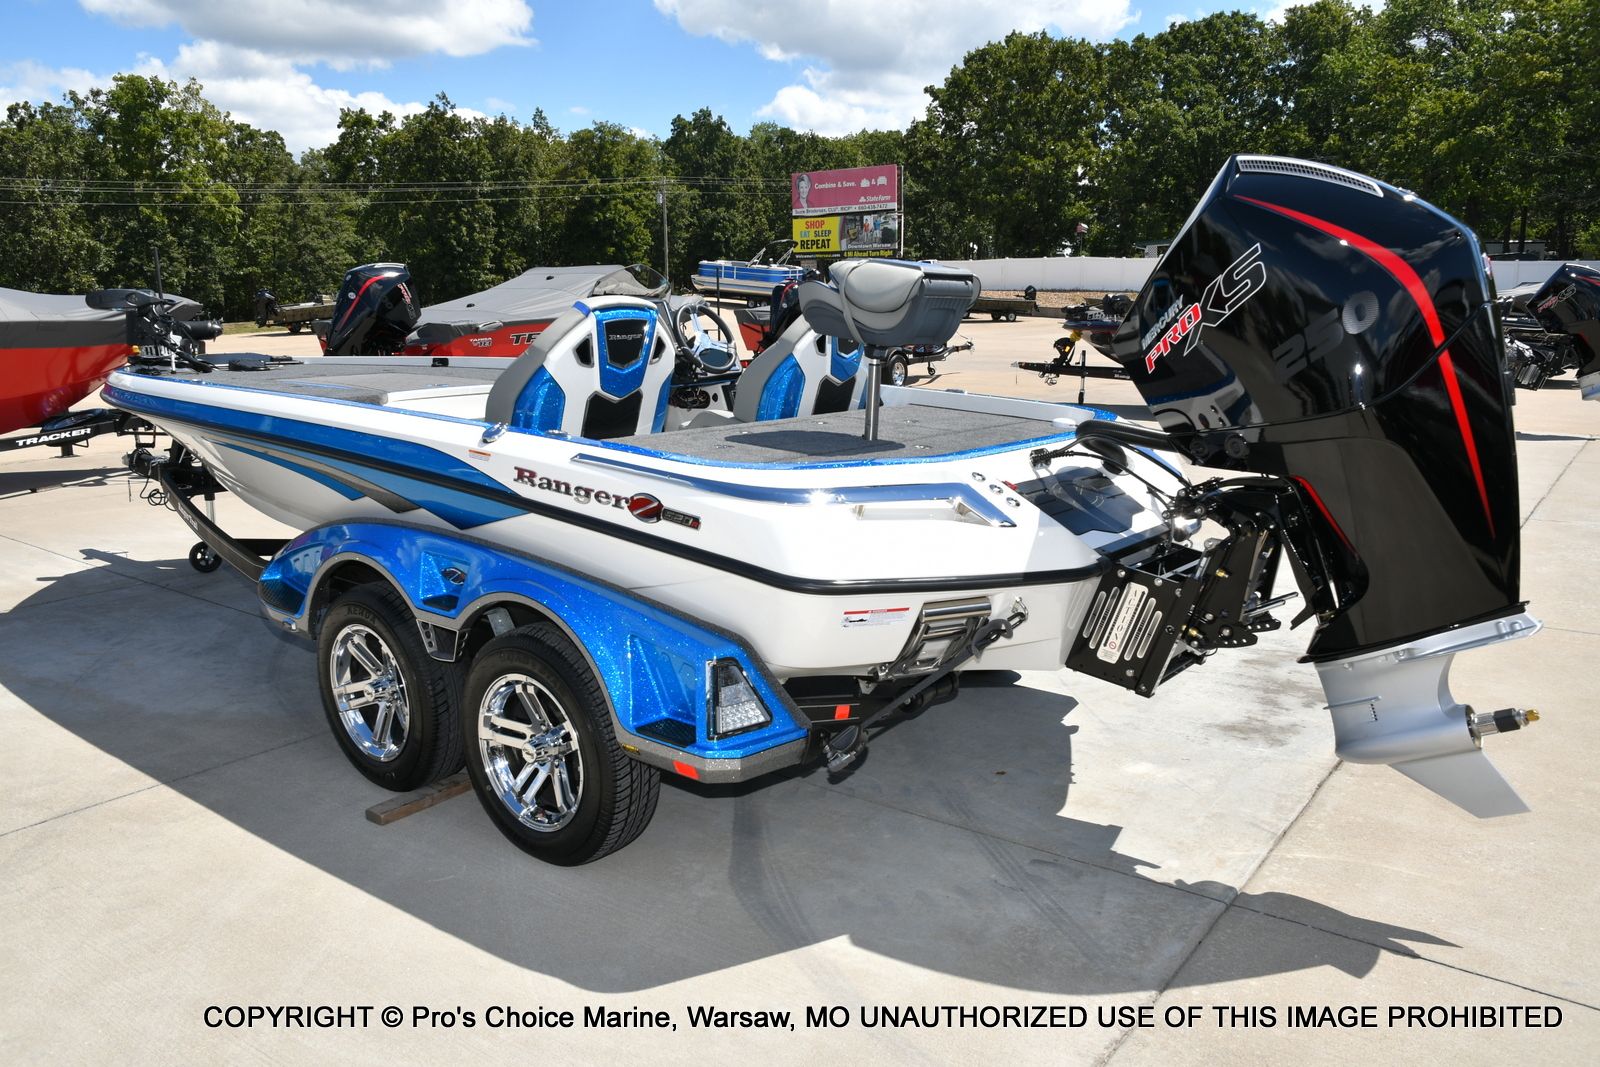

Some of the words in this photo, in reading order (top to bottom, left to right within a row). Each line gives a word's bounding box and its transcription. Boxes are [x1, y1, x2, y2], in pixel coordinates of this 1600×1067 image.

[805, 220, 825, 229] SHOP
[814, 230, 832, 238] SLEEP
[800, 238, 831, 250] REPEAT
[880, 249, 893, 258] Right
[1145, 302, 1202, 374] PRO
[1177, 242, 1267, 357] XS
[1141, 294, 1184, 350] MERCURY
[608, 333, 642, 341] Ranger
[16, 427, 92, 447] TRACKER
[513, 465, 630, 509] Ranger
